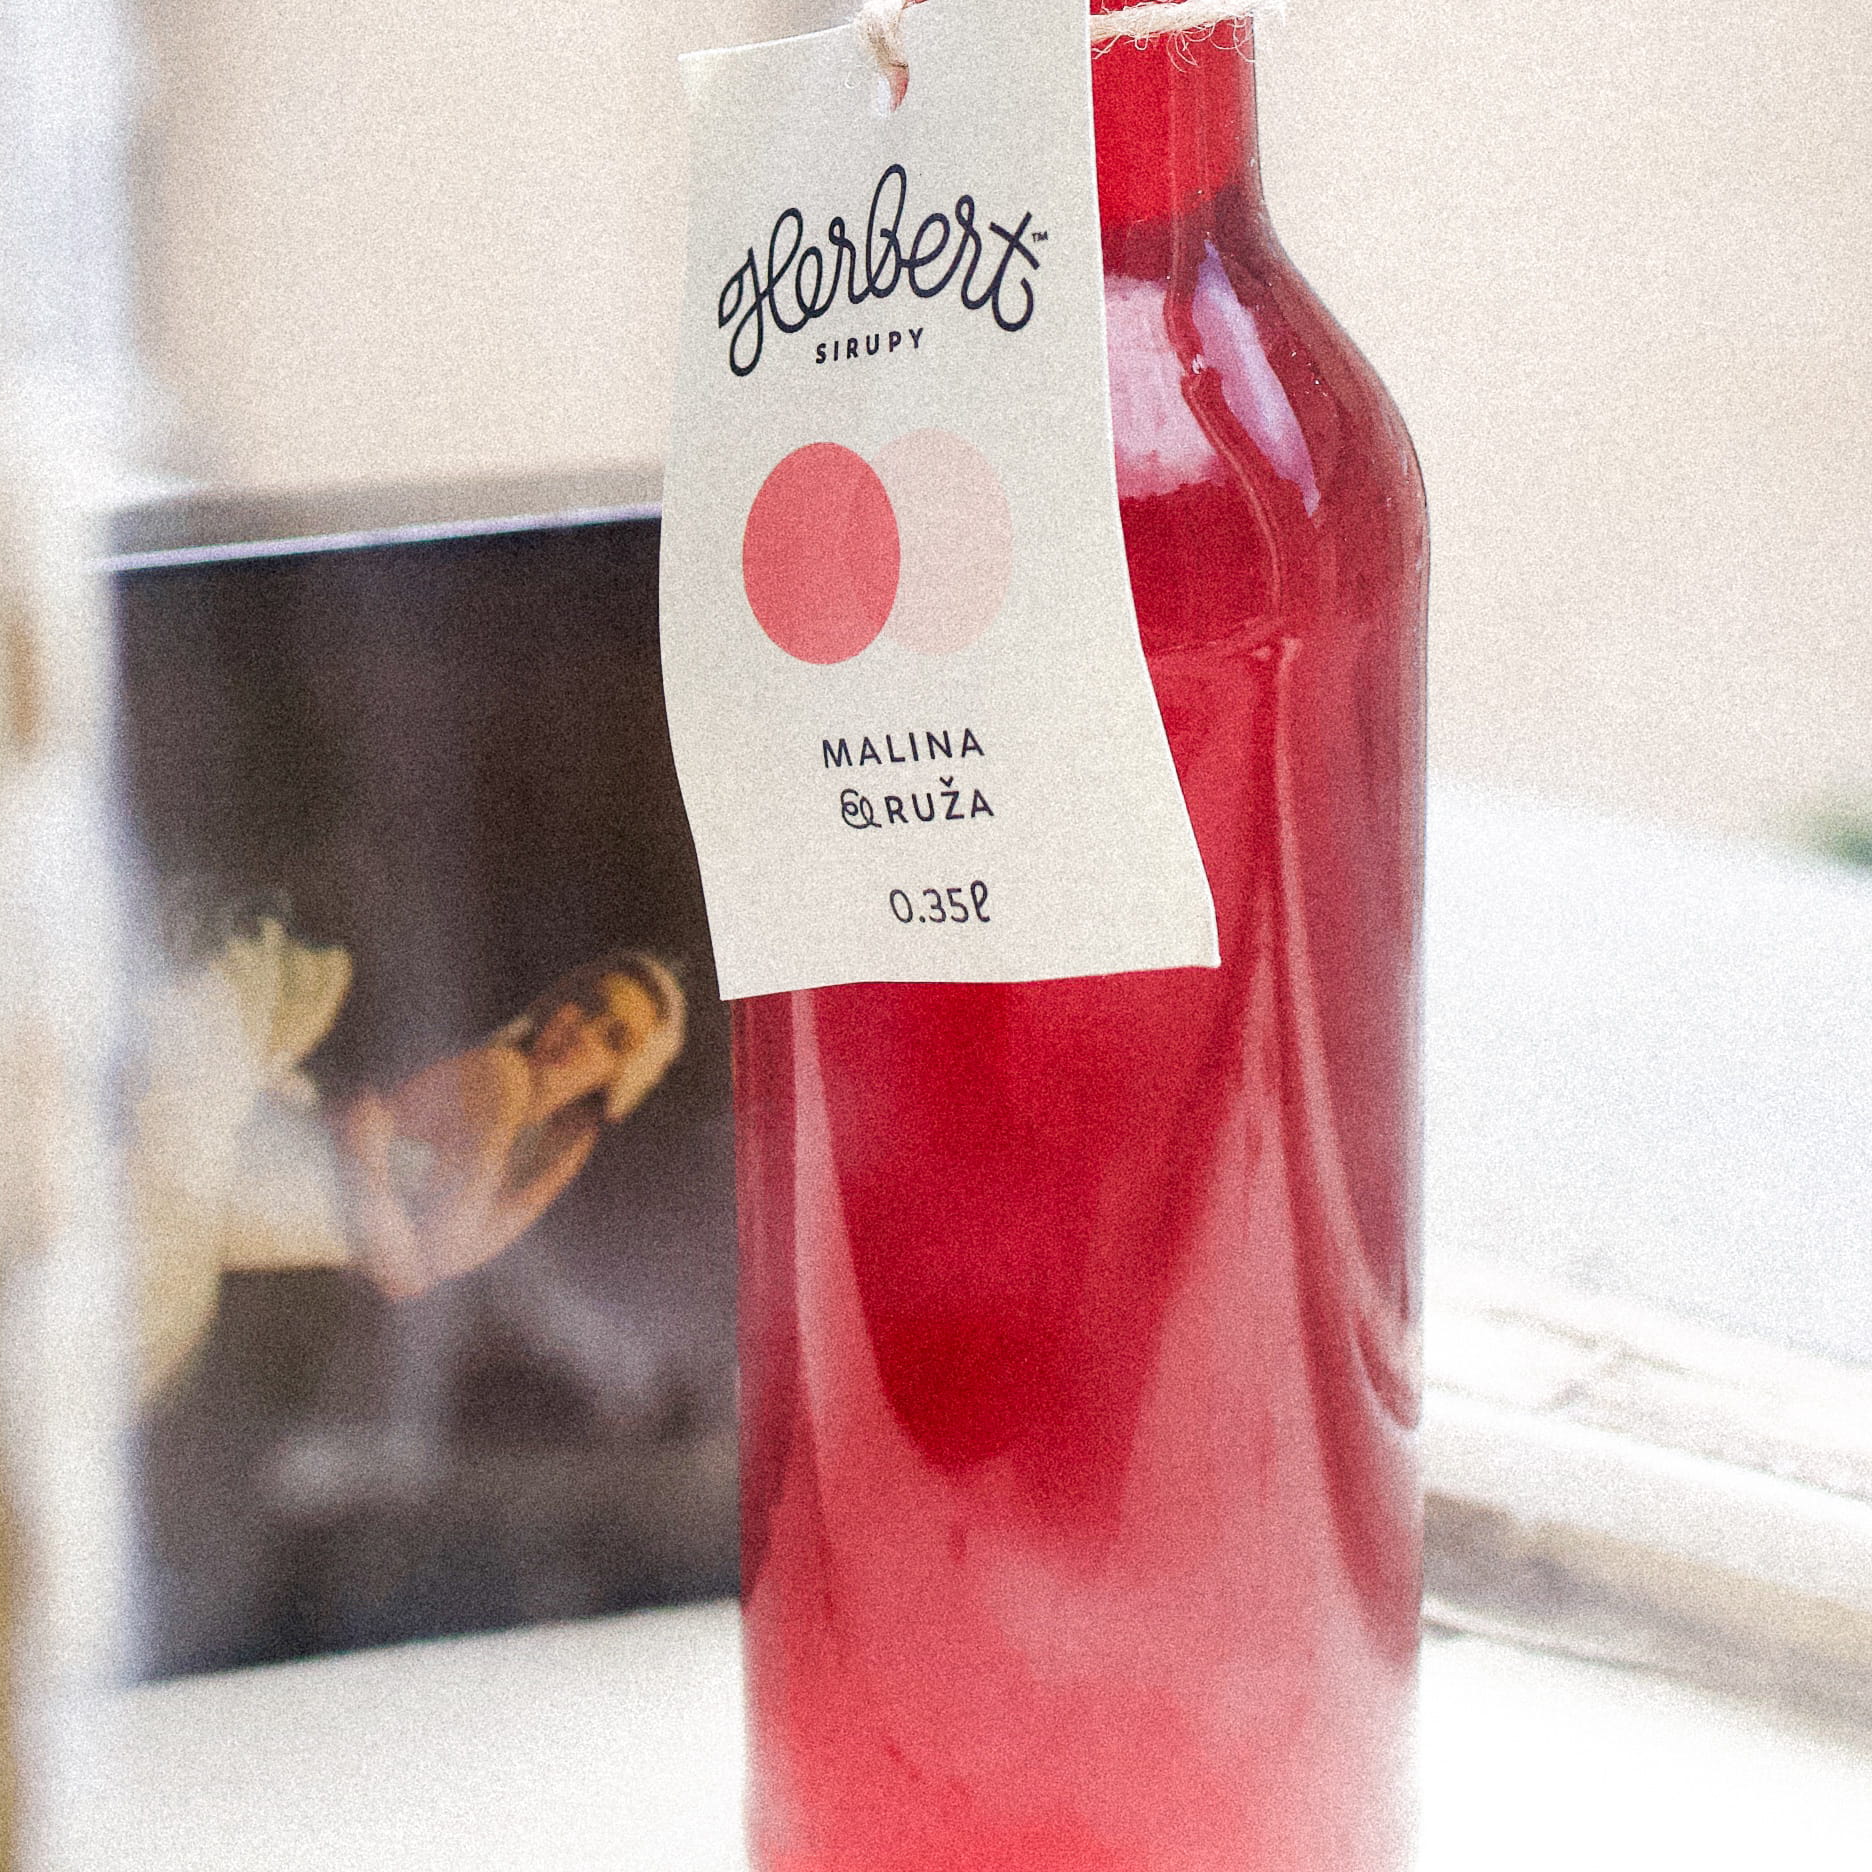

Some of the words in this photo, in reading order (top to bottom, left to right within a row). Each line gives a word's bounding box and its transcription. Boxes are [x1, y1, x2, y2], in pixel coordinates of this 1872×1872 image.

[717, 163, 1040, 377] Herbert
[815, 327, 924, 365] SIRUPY
[822, 728, 985, 769] MALINA
